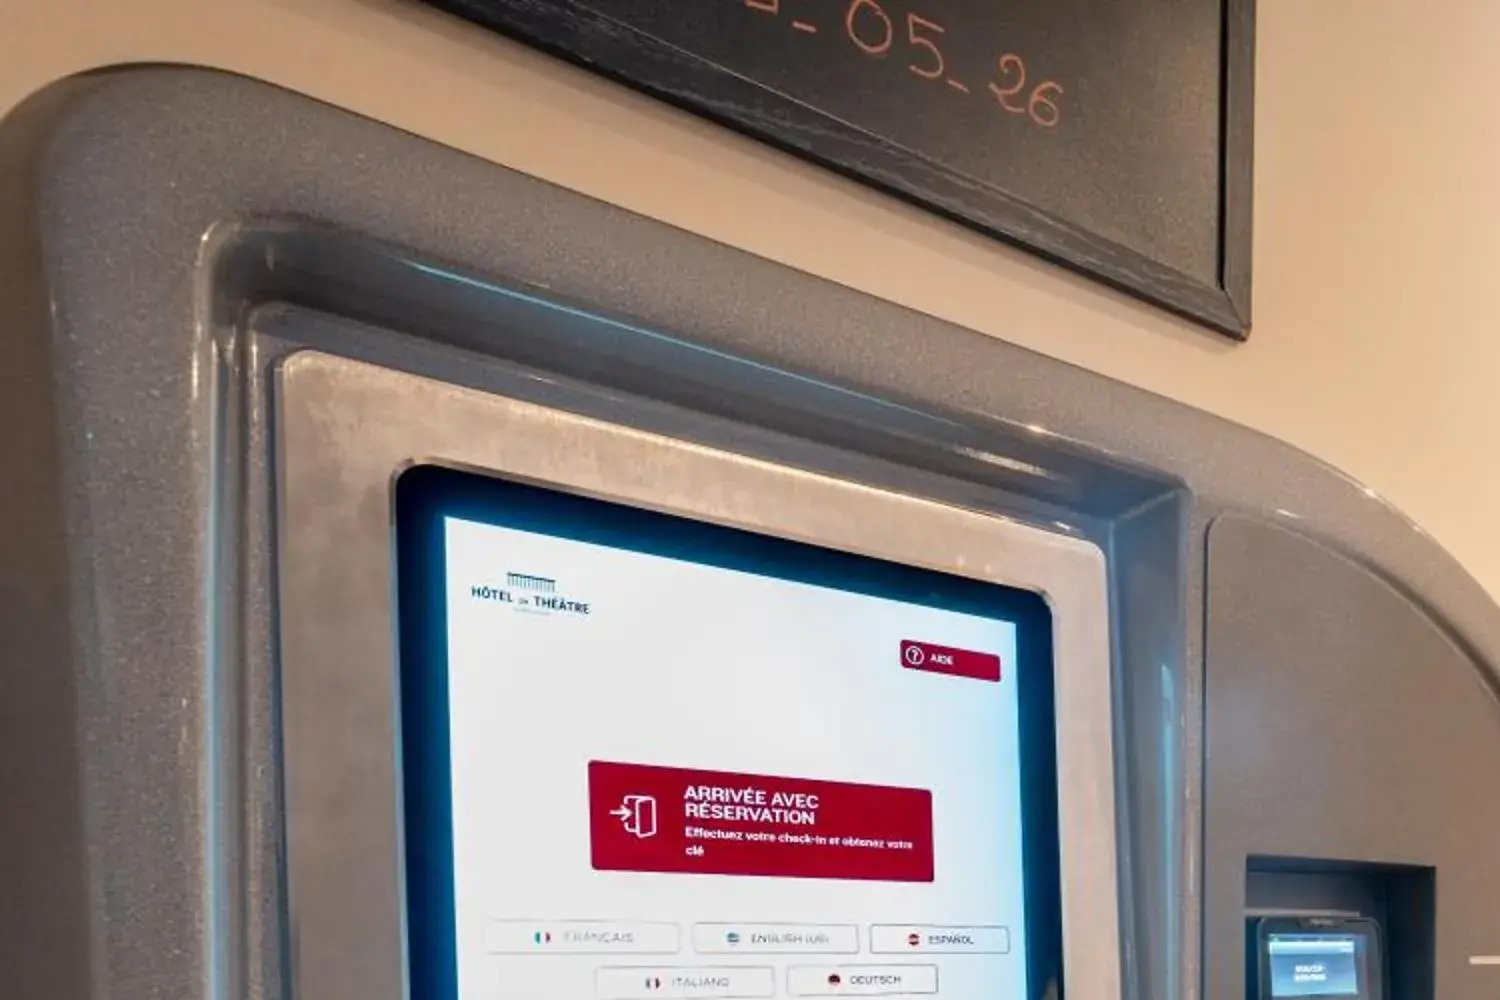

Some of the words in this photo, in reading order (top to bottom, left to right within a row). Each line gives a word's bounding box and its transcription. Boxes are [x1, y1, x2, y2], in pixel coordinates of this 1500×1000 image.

[471, 585, 513, 602] HÔTEL
[684, 785, 767, 805] ARRIVÉE
[771, 792, 819, 809] AVEC
[685, 802, 815, 825] RÉSERVATION
[685, 826, 743, 841] Effectuez
[745, 832, 775, 843] votre
[778, 833, 827, 846] check-in
[829, 836, 840, 846] et
[928, 933, 975, 945] ESPAÑOL
[671, 977, 730, 988] ITALIANO
[850, 975, 902, 985] DEUTSCH
